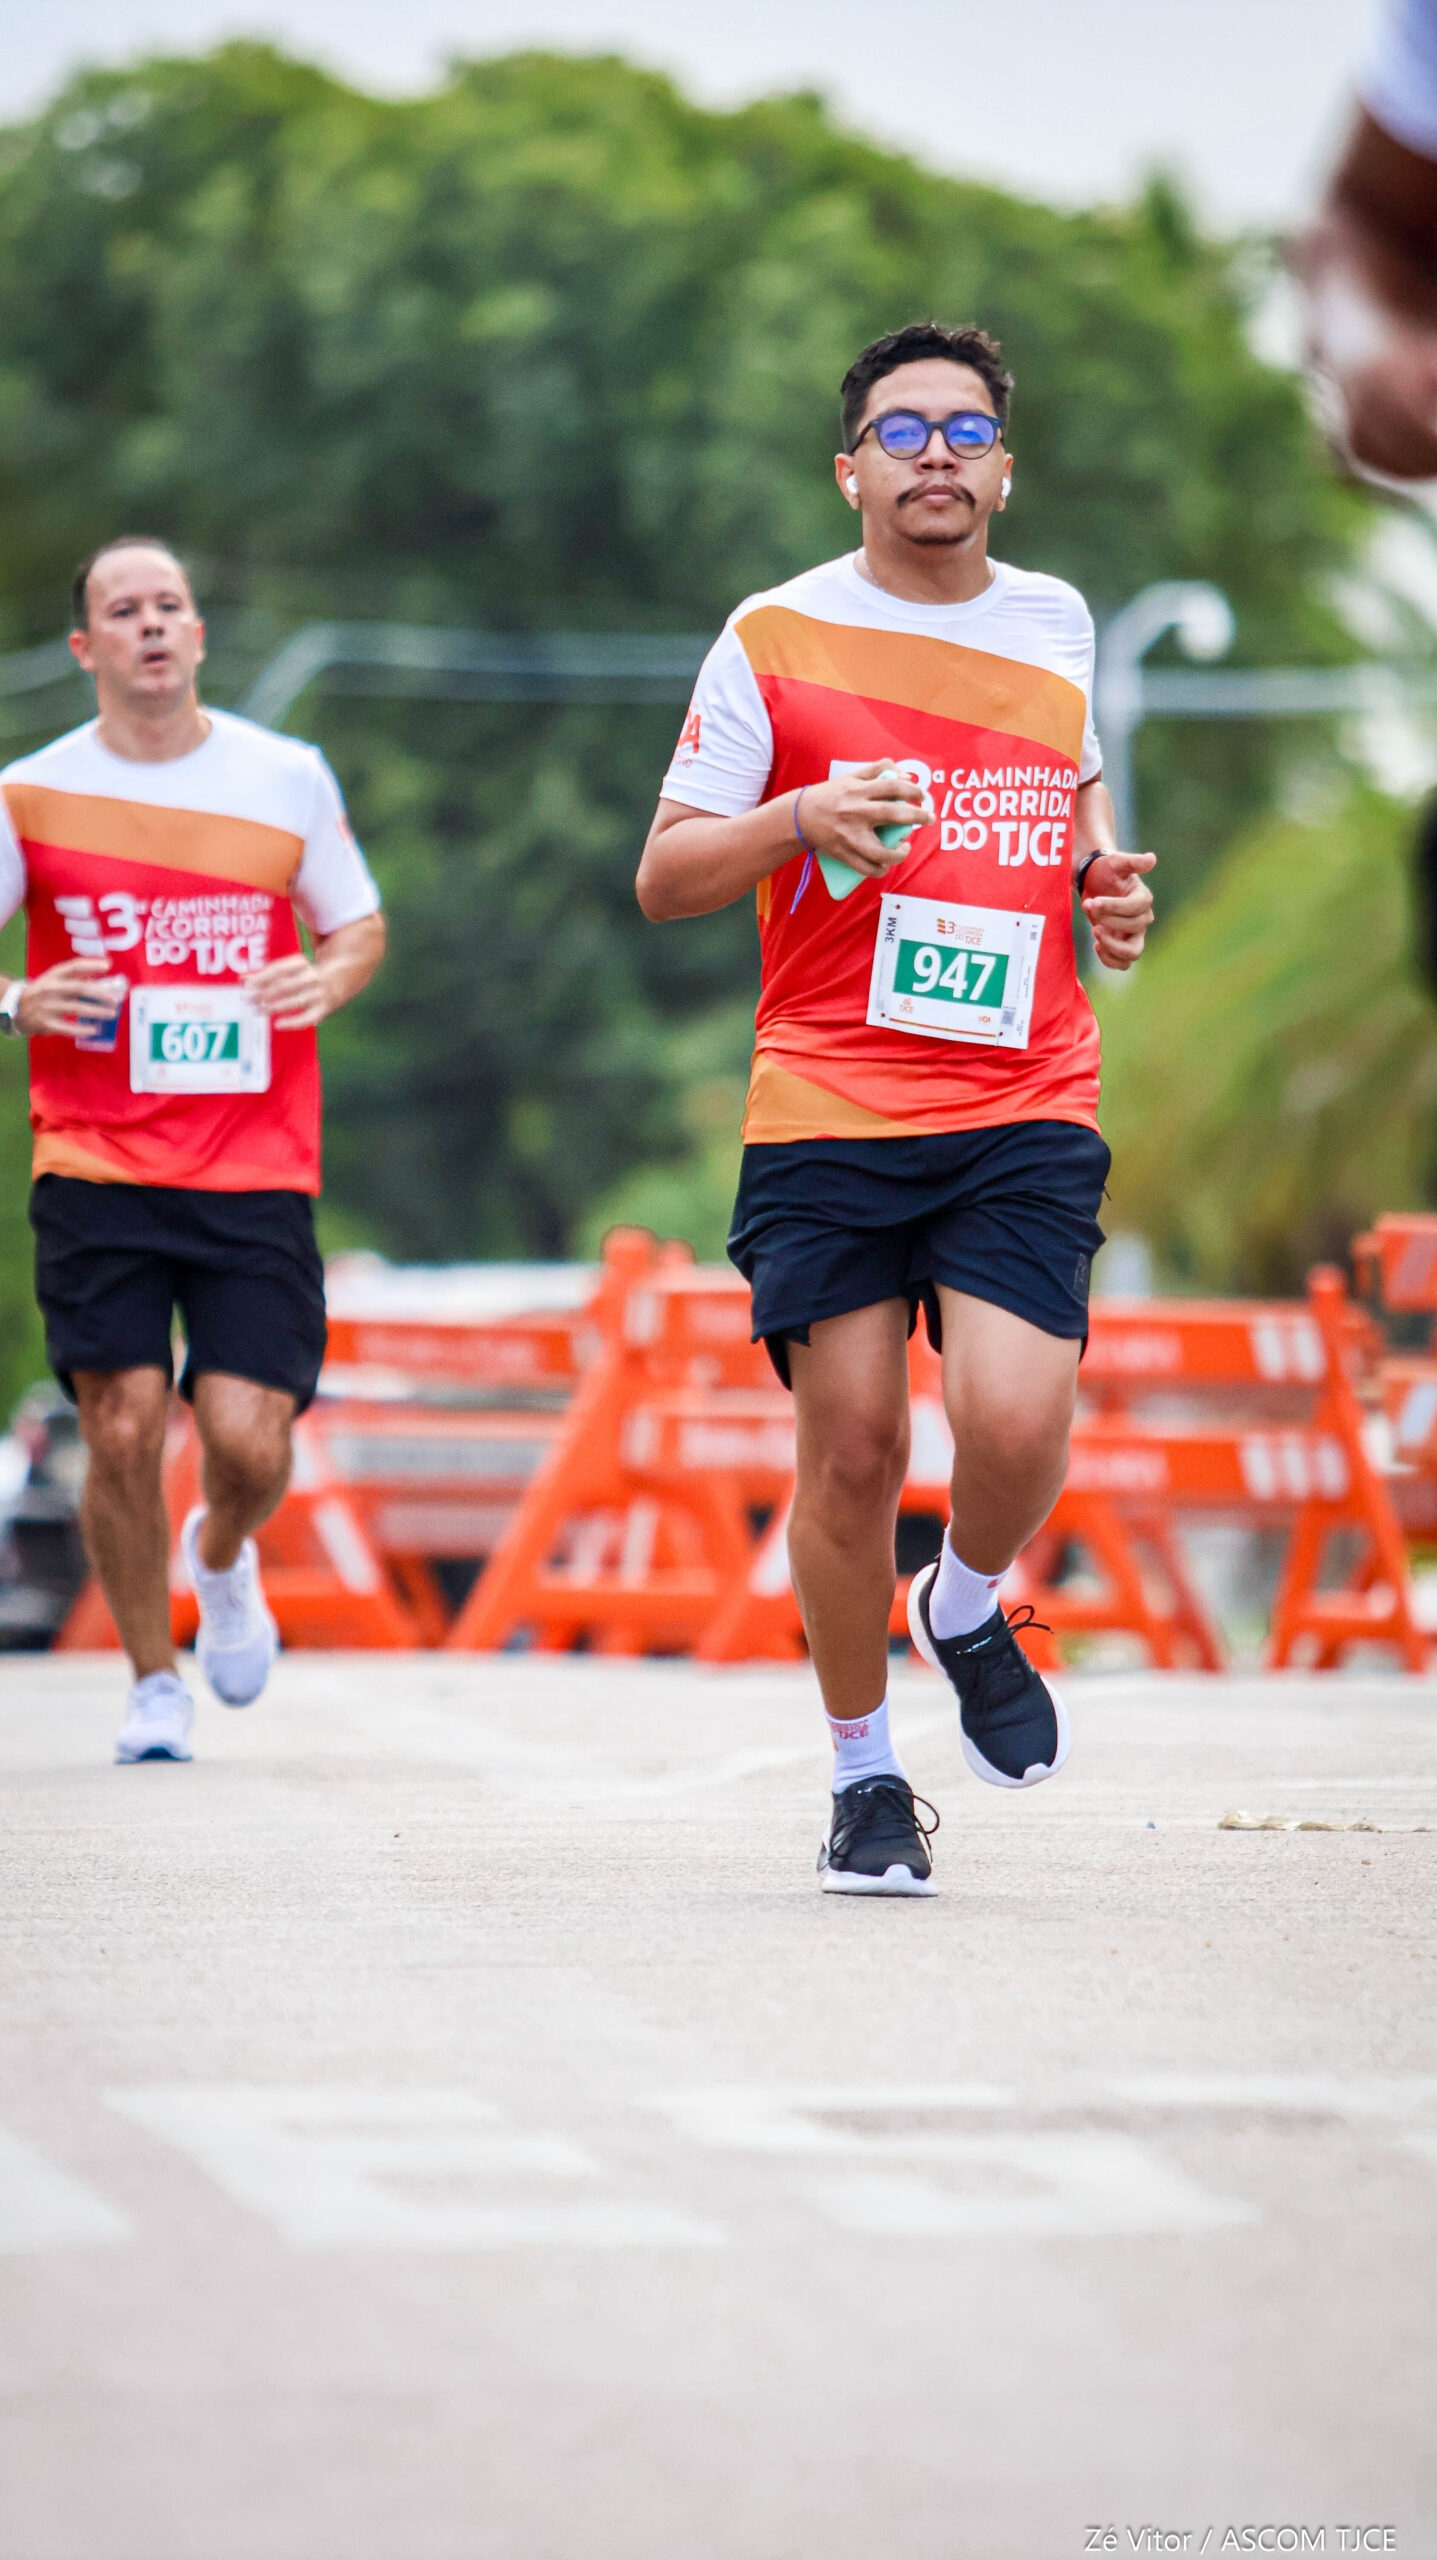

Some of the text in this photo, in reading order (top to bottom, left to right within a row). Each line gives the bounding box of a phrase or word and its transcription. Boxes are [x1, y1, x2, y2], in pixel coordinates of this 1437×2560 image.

[951, 766, 1078, 790] CAMINHADA
[940, 789, 1071, 819] /CORRIDA
[940, 820, 1067, 867] DO TJCE
[884, 916, 897, 944] 3KM
[145, 934, 267, 975] DO TJCE
[912, 945, 997, 1002] 947
[161, 1022, 231, 1062] 607
